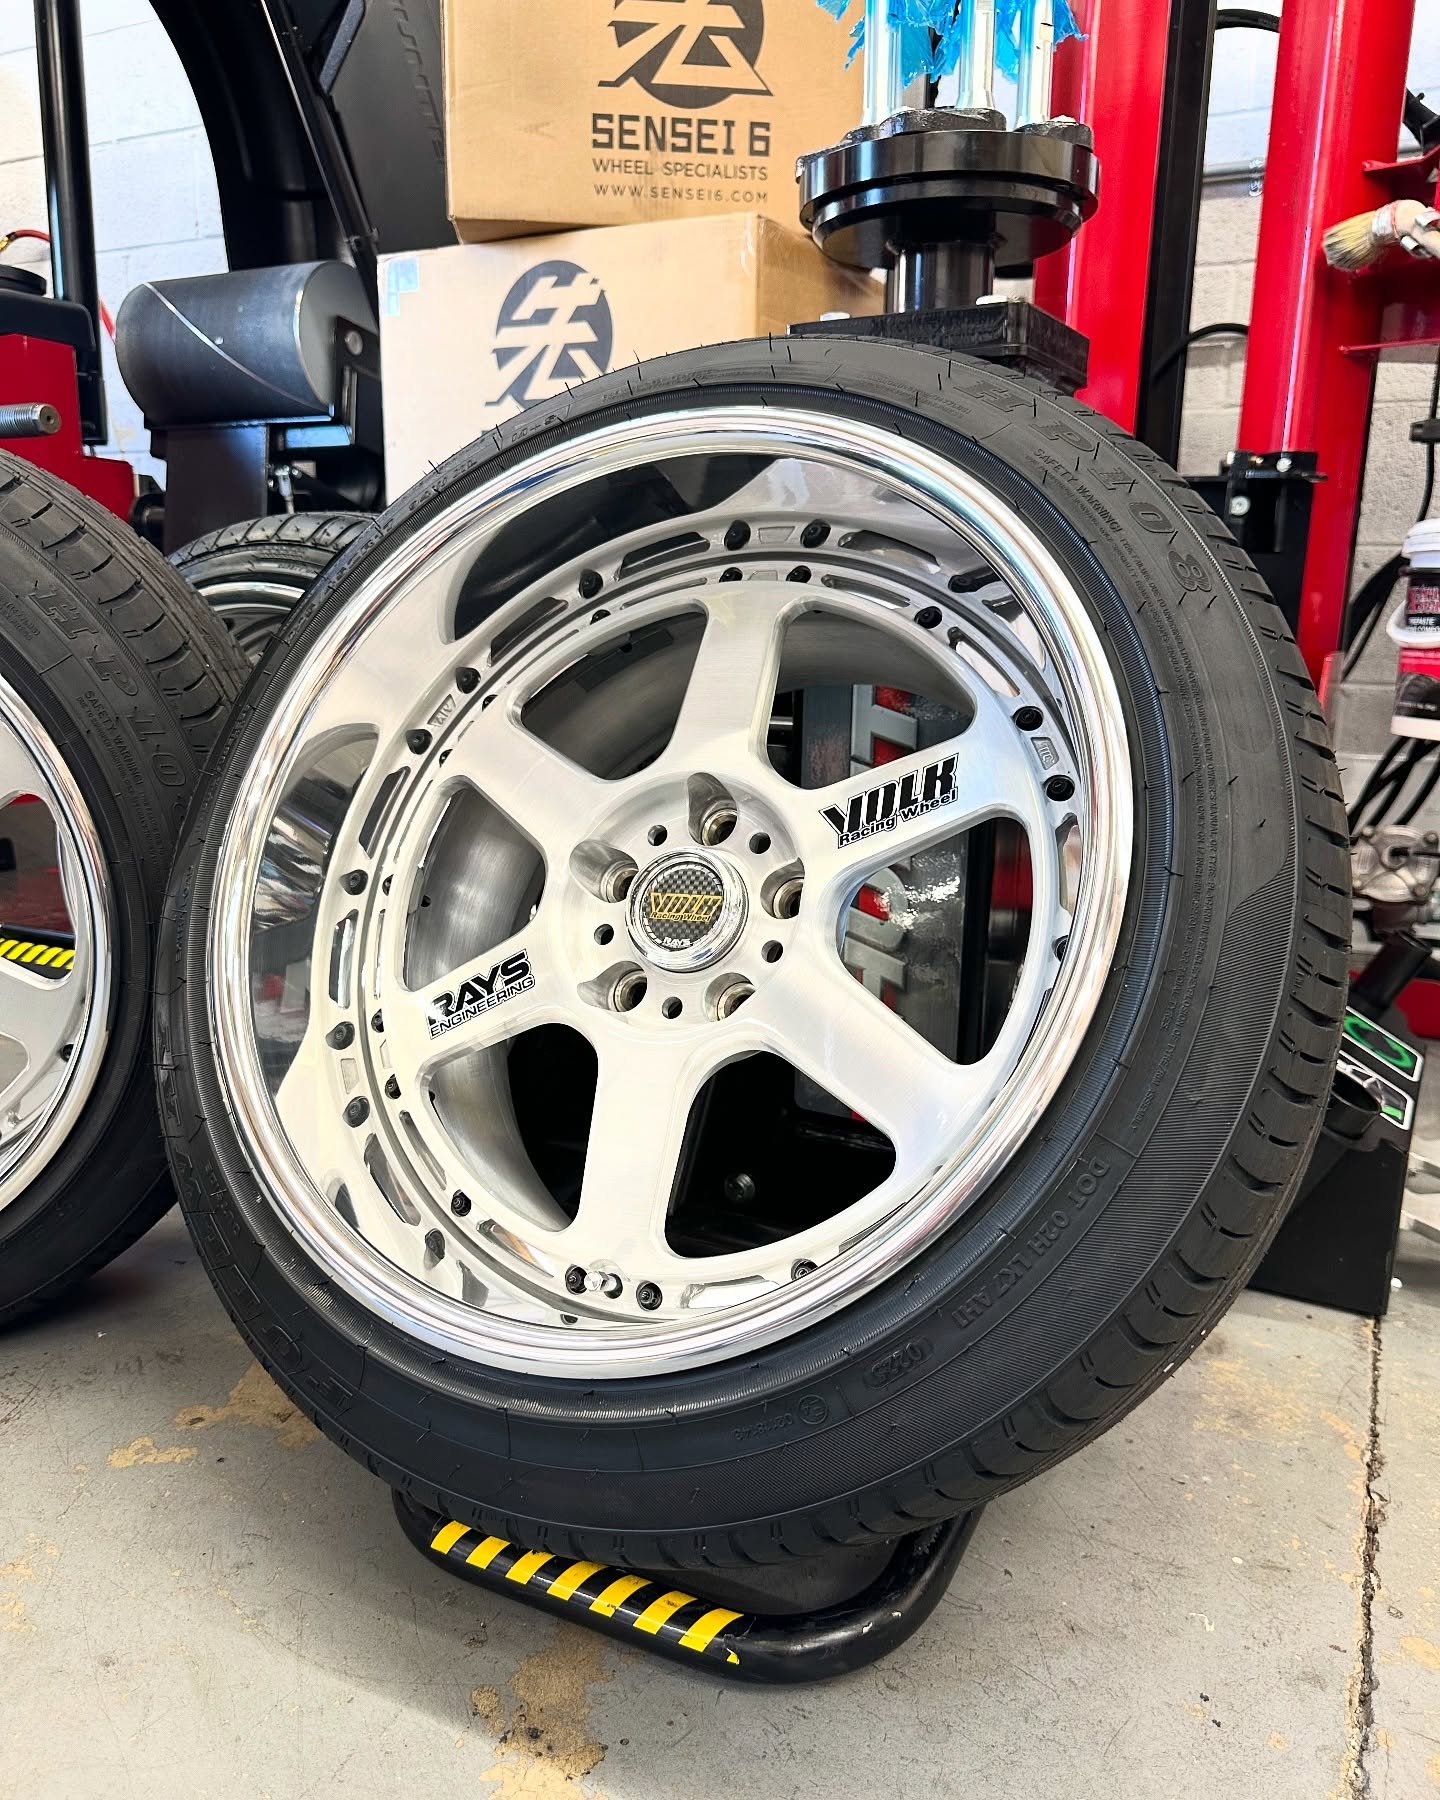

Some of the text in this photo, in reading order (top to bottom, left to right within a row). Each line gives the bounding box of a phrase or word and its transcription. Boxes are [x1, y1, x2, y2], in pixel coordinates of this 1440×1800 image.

[592, 112, 770, 157] SENSEI 6
[592, 158, 768, 181] WHEEL SPECIALISTS
[594, 183, 768, 204] WWW.SENSEI6.COM
[1032, 446, 1079, 487] SAFETY
[1074, 480, 1123, 536] WARNING!
[83, 688, 118, 734] SAFETY
[113, 734, 145, 786] WARNING!
[821, 755, 957, 834] VOLK
[838, 788, 958, 848] Racing Wheel
[650, 911, 713, 923] Racing Wheel
[428, 951, 530, 1027] RAYS
[430, 976, 535, 1037] ENGINEERING
[1063, 1154, 1112, 1211] DOT
